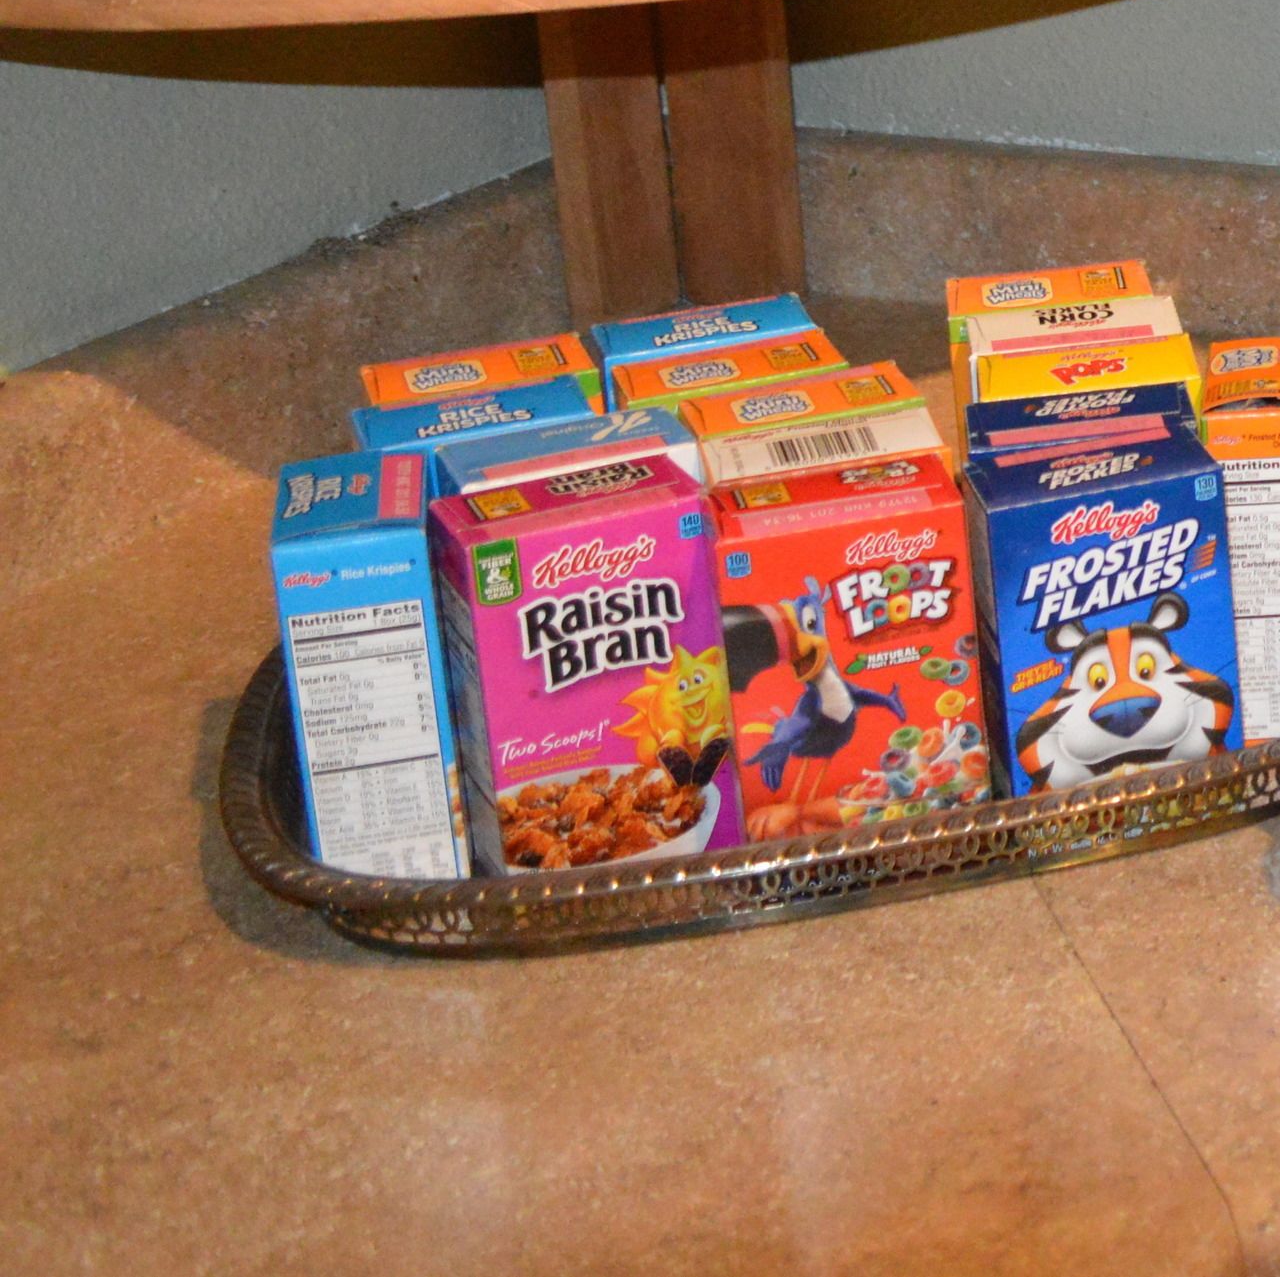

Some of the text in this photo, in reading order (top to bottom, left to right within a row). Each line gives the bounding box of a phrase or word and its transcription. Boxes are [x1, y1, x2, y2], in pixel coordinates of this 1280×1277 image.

[1034, 302, 1111, 316] FLAKES
[1038, 309, 1115, 326] CORN
[653, 320, 760, 347] KRISPIES
[672, 316, 732, 333] RICE
[416, 409, 533, 439] KRISPIES
[438, 402, 502, 425] RICE
[549, 465, 654, 495] Raisin
[1037, 452, 1141, 485] FROSTED
[1048, 462, 1136, 491] FLAKES
[1197, 477, 1215, 490] 130
[682, 513, 700, 526] 140
[1050, 500, 1160, 544] Kellogg's
[726, 554, 749, 566] 100
[846, 528, 938, 565] Kellogg's
[1022, 518, 1199, 602] FROSTED
[283, 562, 411, 588] Kellogg's Rice Krispies
[485, 567, 504, 584] &
[532, 534, 656, 589] Kellogg's
[836, 559, 952, 611] FROOT
[1035, 552, 1186, 630] FLAKES
[290, 603, 420, 629] Nutrition Facts
[522, 581, 682, 655] Raisin
[849, 589, 952, 637] LOOPS
[296, 653, 332, 665] Calories
[547, 624, 671, 689] Bran
[868, 646, 917, 664] NATURAL
[322, 674, 337, 684] Fat
[497, 737, 537, 767] Two
[539, 721, 605, 756] Scoops!
